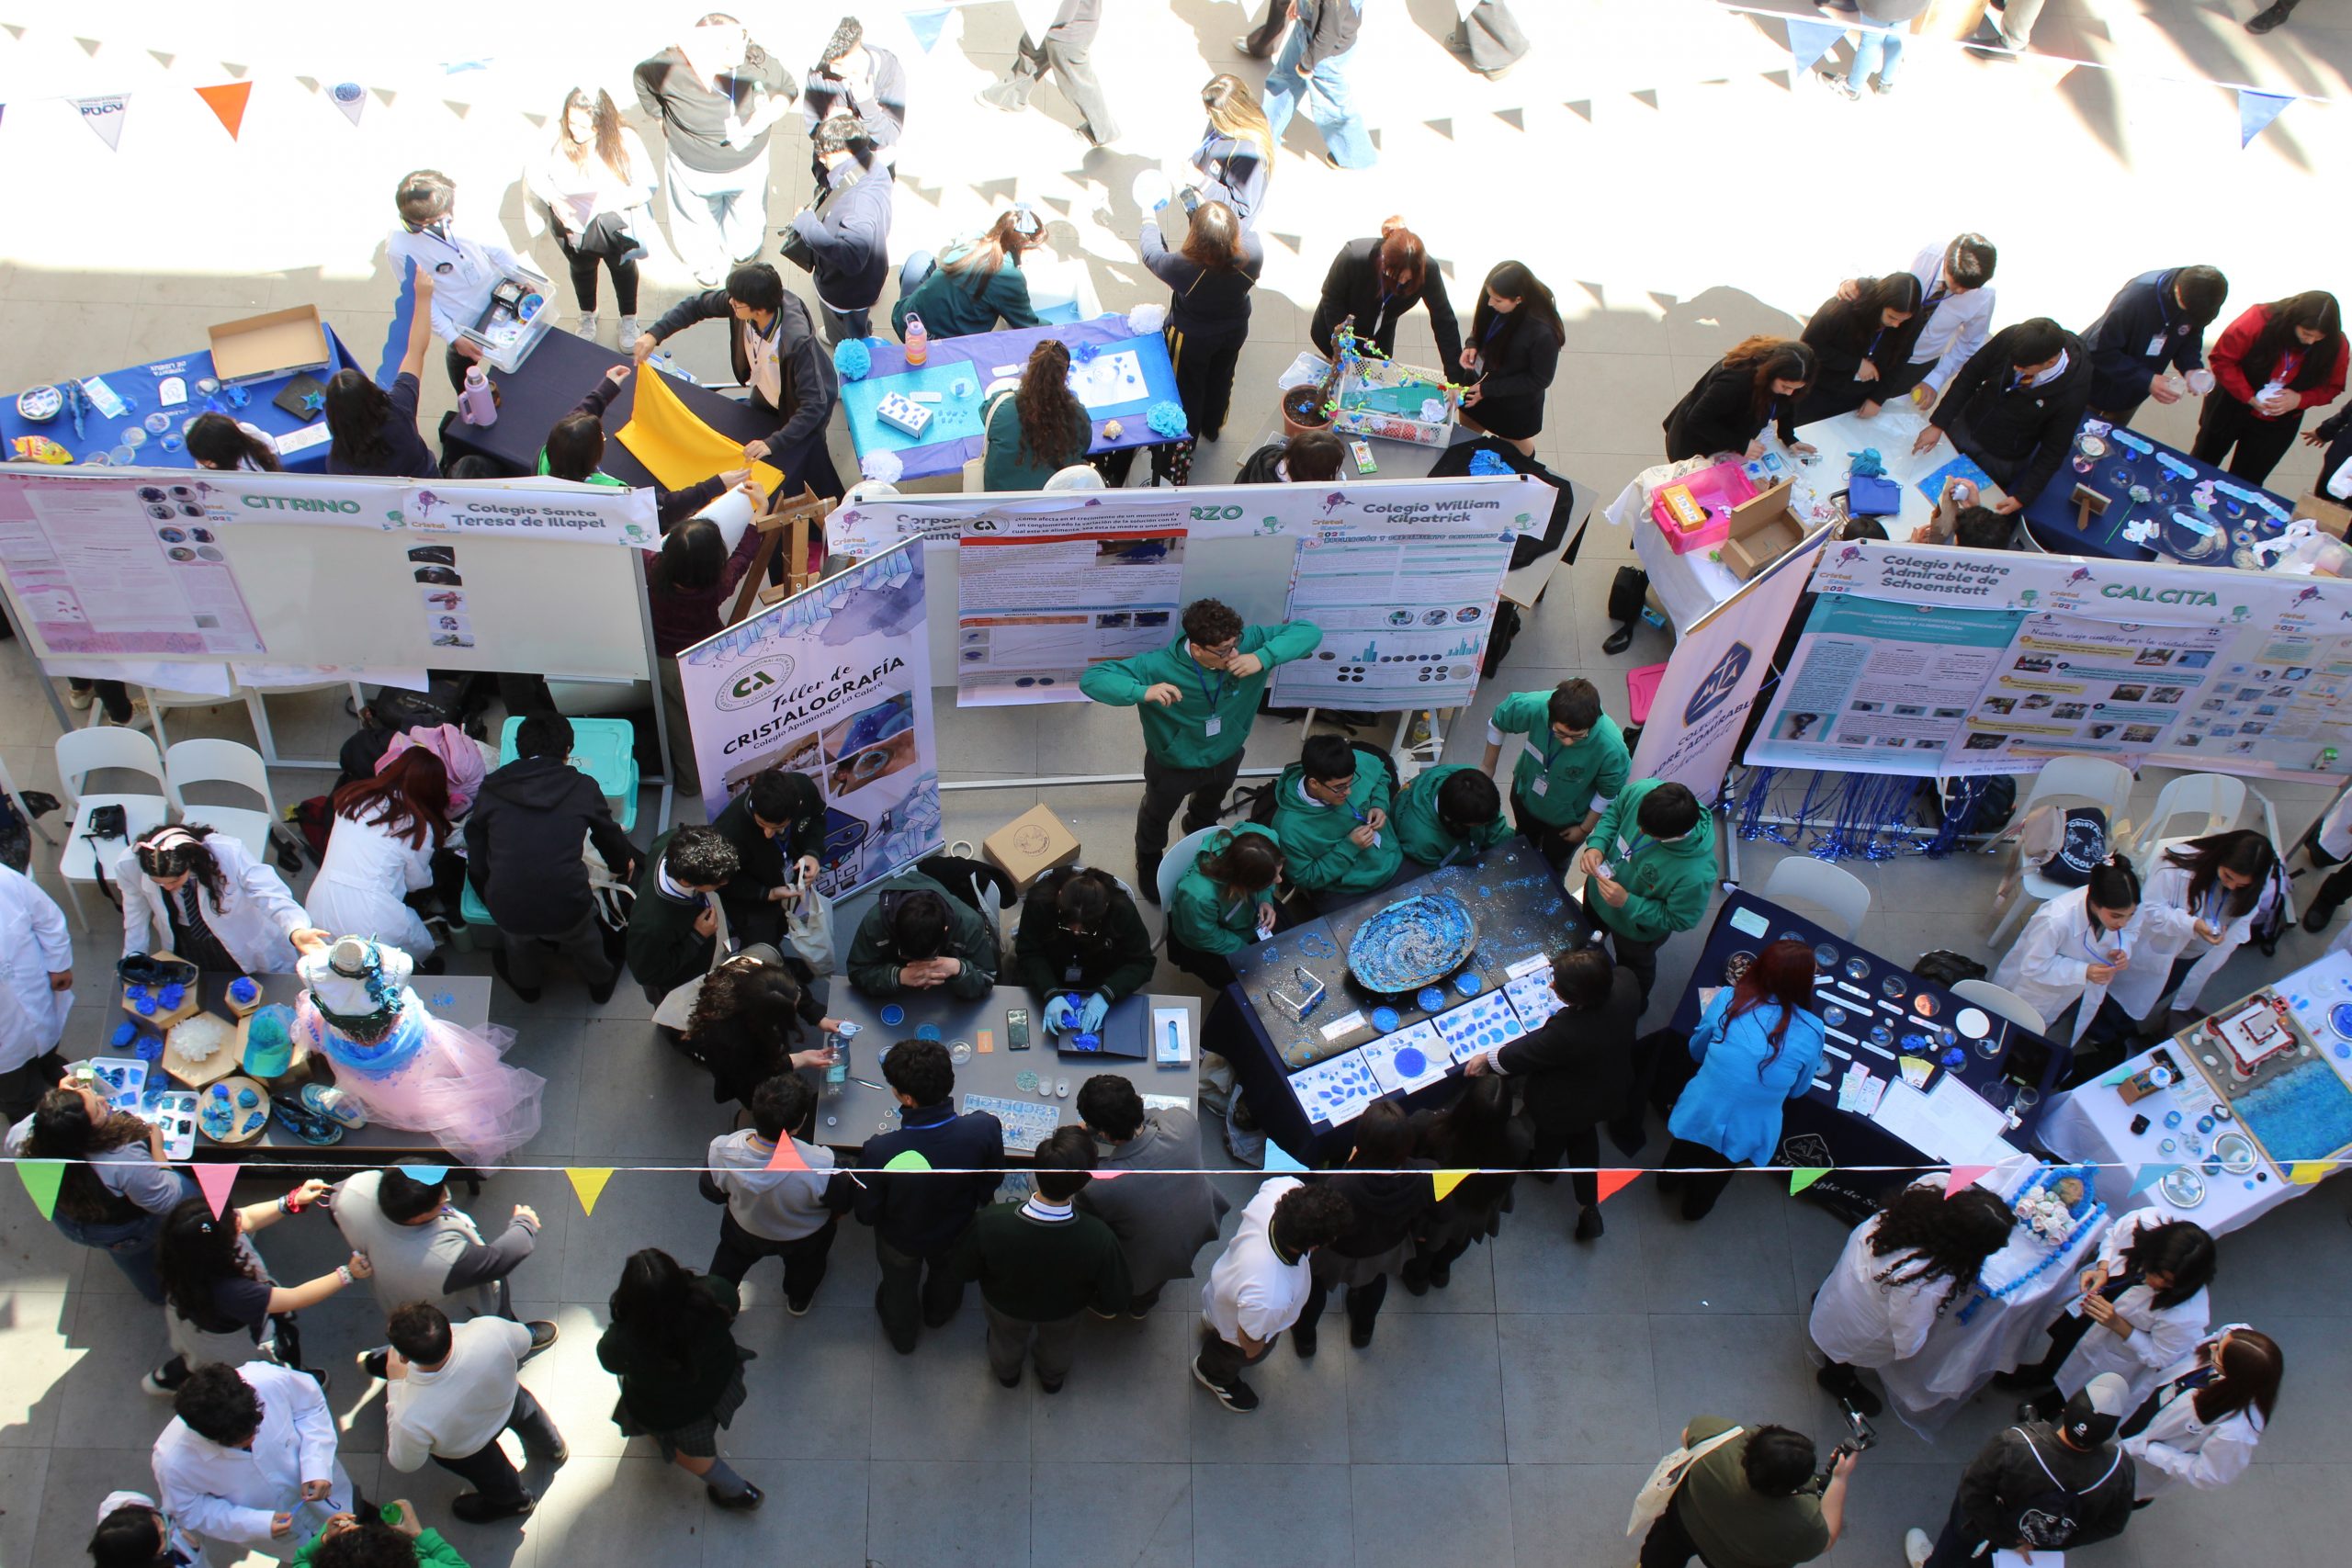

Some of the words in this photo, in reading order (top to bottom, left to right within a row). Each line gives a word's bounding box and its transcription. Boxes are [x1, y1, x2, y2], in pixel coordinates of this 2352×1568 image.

[241, 494, 361, 514] CITRINO
[467, 503, 537, 517] Colegio
[543, 507, 597, 517] Santa
[1363, 502, 1430, 515] Colegio
[1435, 500, 1500, 512] William
[1190, 505, 1243, 521] RZO
[1386, 512, 1471, 525] Kilpatrick
[412, 521, 447, 529] Cristal
[451, 514, 515, 528] Teresa
[521, 516, 543, 527] de
[548, 518, 606, 531] Illapel
[832, 537, 866, 547] Cristal
[1883, 555, 1949, 570] Colegio
[1953, 561, 2010, 576] Madre
[1819, 571, 1852, 581] Cristal
[1882, 566, 1973, 583] Admirable
[1977, 574, 1999, 586] de
[1881, 578, 1990, 596] Schoenstatt
[2100, 583, 2218, 606] CALCITA
[2031, 628, 2063, 637] Nuestro
[772, 680, 824, 713] Taller
[830, 664, 853, 682] de
[722, 656, 906, 756] CRISTALOGRAFÍA
[753, 730, 787, 750] Colegio
[786, 704, 842, 735] Apumanque
[842, 696, 854, 707] La
[854, 681, 884, 699] Calera
[1678, 710, 1723, 746] COLEGIO
